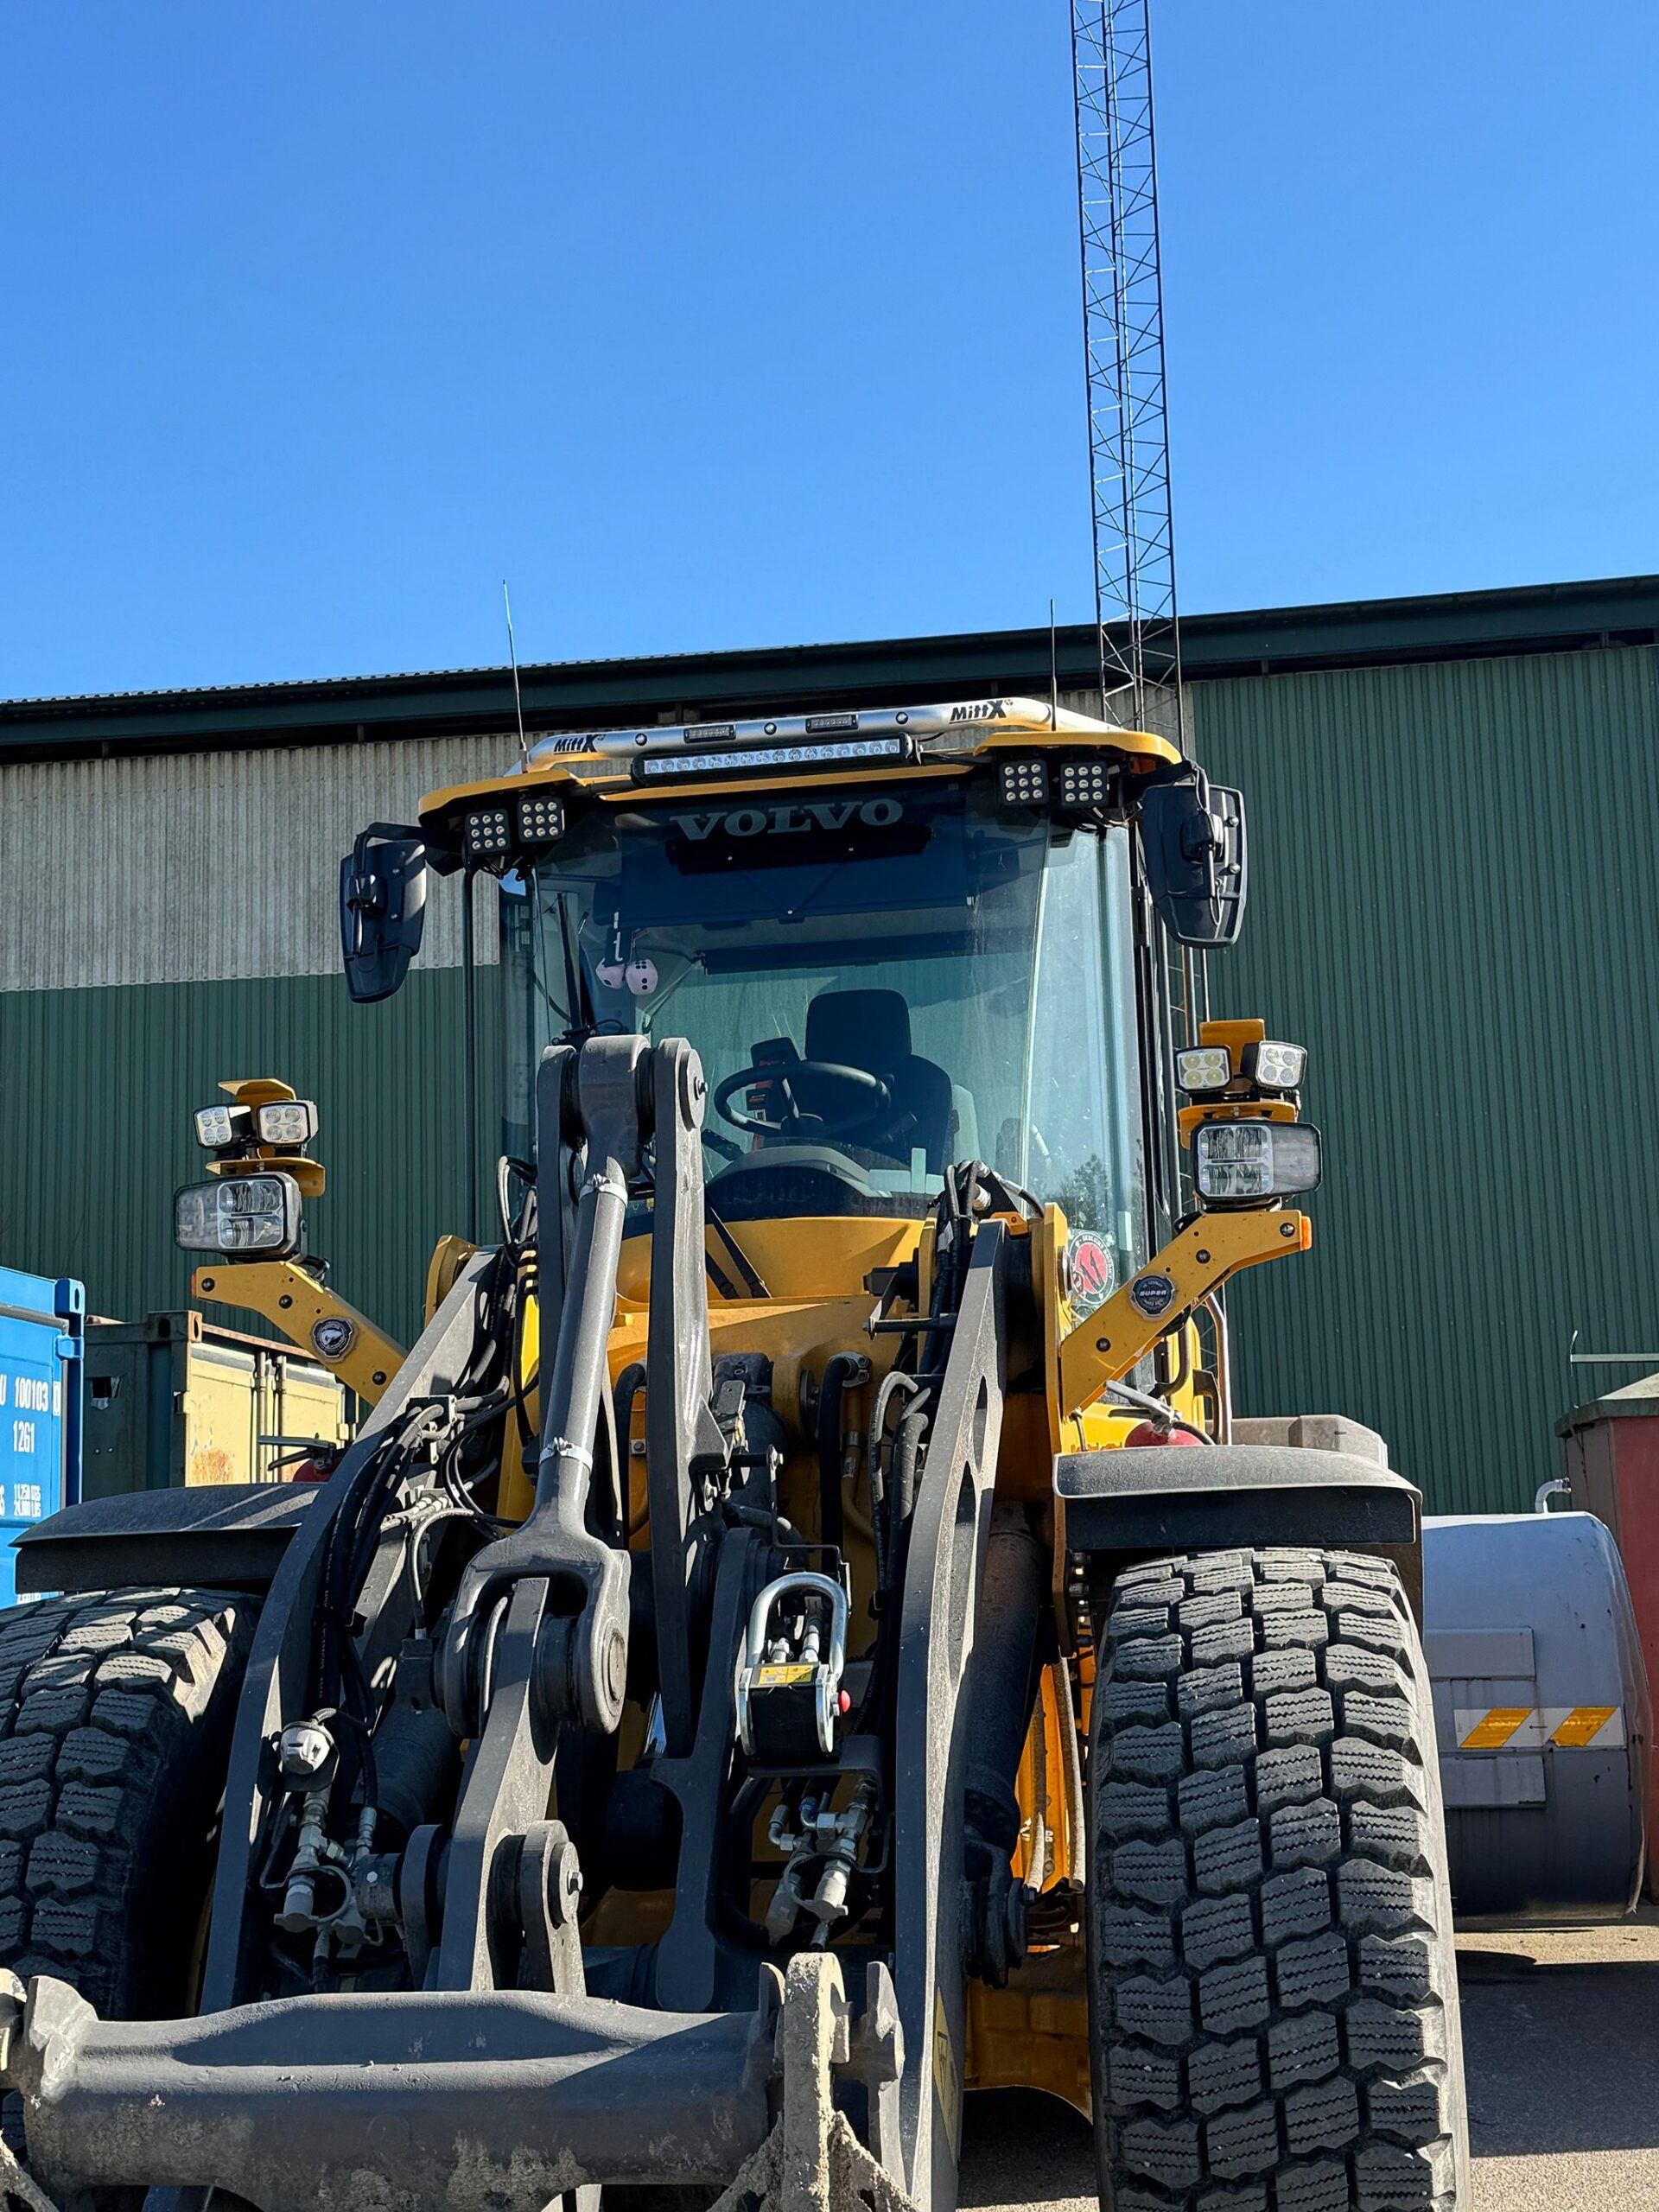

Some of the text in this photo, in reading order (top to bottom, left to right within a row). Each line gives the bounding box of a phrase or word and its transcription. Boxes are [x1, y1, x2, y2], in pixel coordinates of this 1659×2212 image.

[950, 700, 1007, 721] MittX
[554, 734, 599, 753] MittX
[670, 798, 903, 841] VOLVO
[15, 1376, 48, 1412] 100103
[13, 1420, 35, 1453] 12G1
